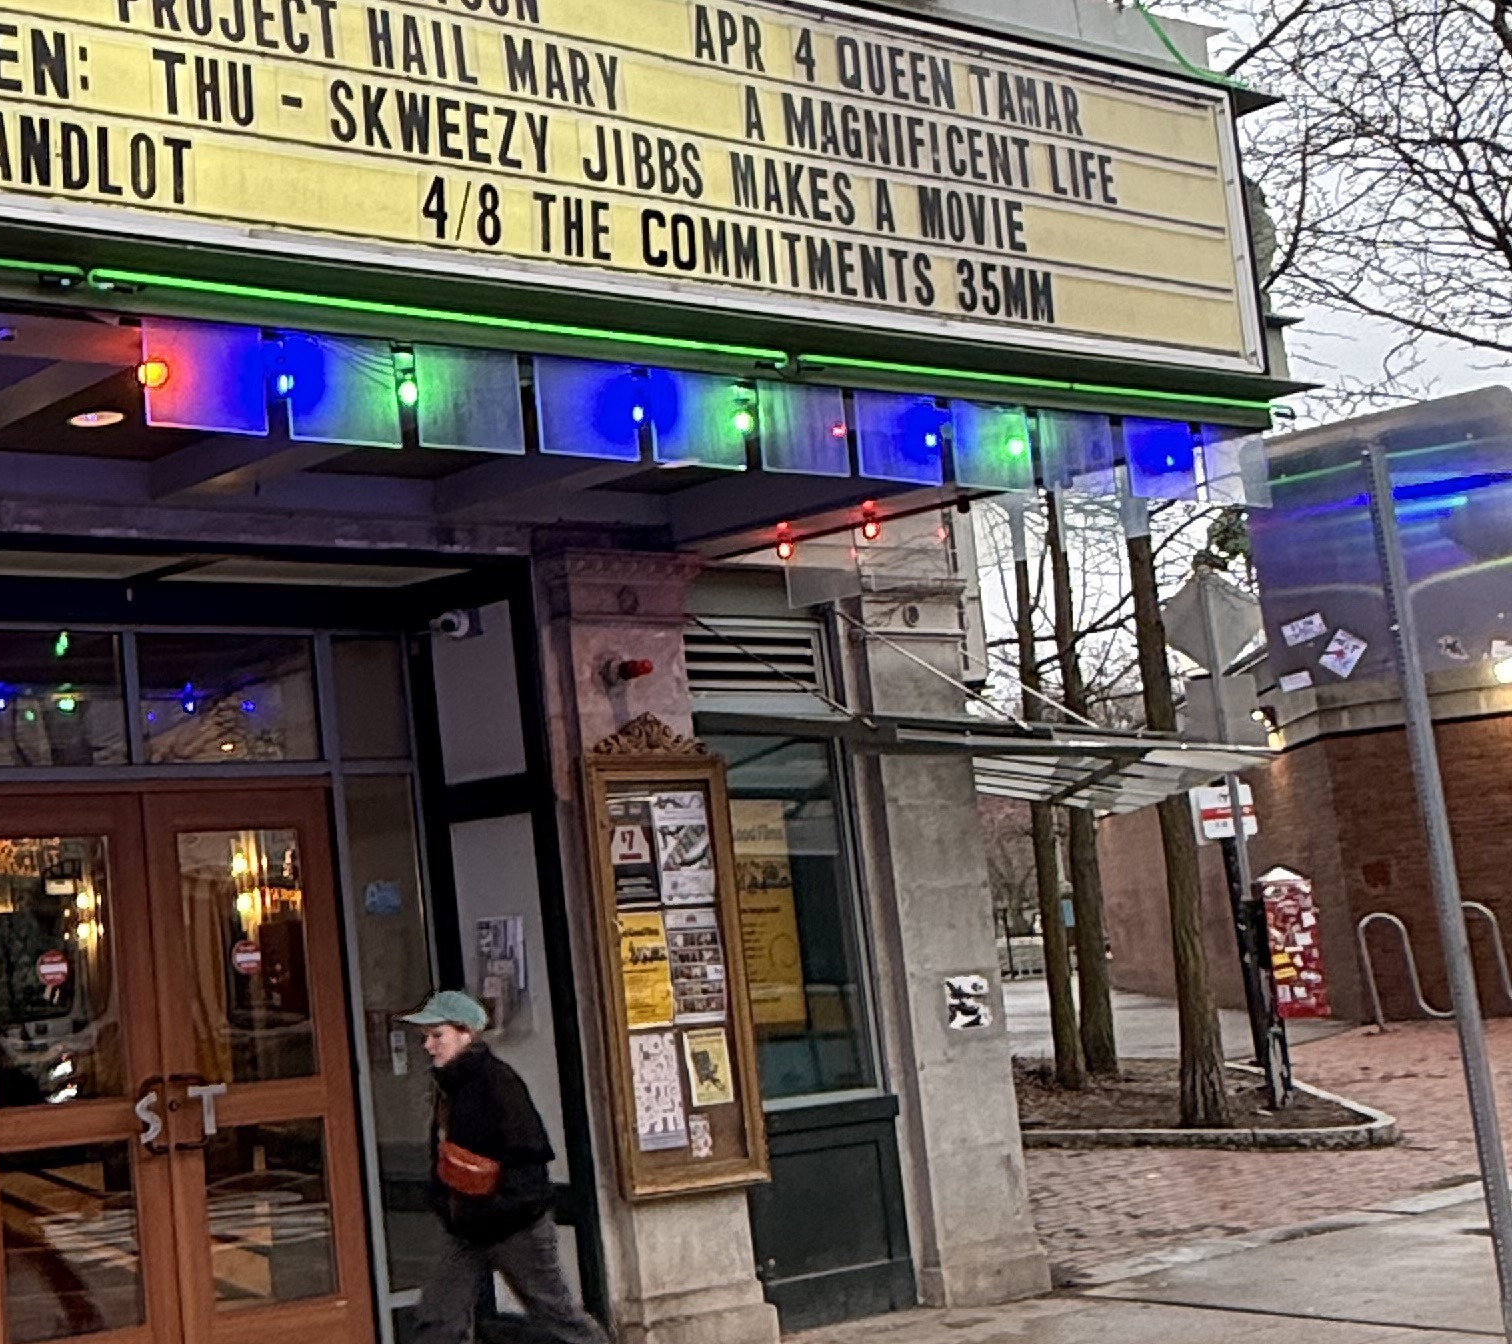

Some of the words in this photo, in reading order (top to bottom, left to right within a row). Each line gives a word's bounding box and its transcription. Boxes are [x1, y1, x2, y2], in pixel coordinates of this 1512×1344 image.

[151, 47, 255, 127] THU
[330, 79, 549, 174] SKWEEZY
[582, 124, 705, 200] JIBBS
[729, 151, 857, 227] MAKES
[875, 177, 896, 233] A
[918, 184, 1028, 253] MOVIE
[366, 7, 479, 86] HAIL
[502, 33, 619, 112] MARY
[744, 85, 766, 141] A
[781, 91, 1030, 189] MAGNIFICENT
[1048, 144, 1118, 205] LIFE
[694, 4, 766, 72] APR
[794, 27, 816, 82] 4
[837, 35, 956, 111] QUEEN
[968, 64, 1084, 137] TAMAR
[422, 175, 502, 246] 4/8
[532, 191, 612, 262] THE
[640, 207, 935, 307] COMMITMENTS
[957, 256, 1055, 325] 35MM
